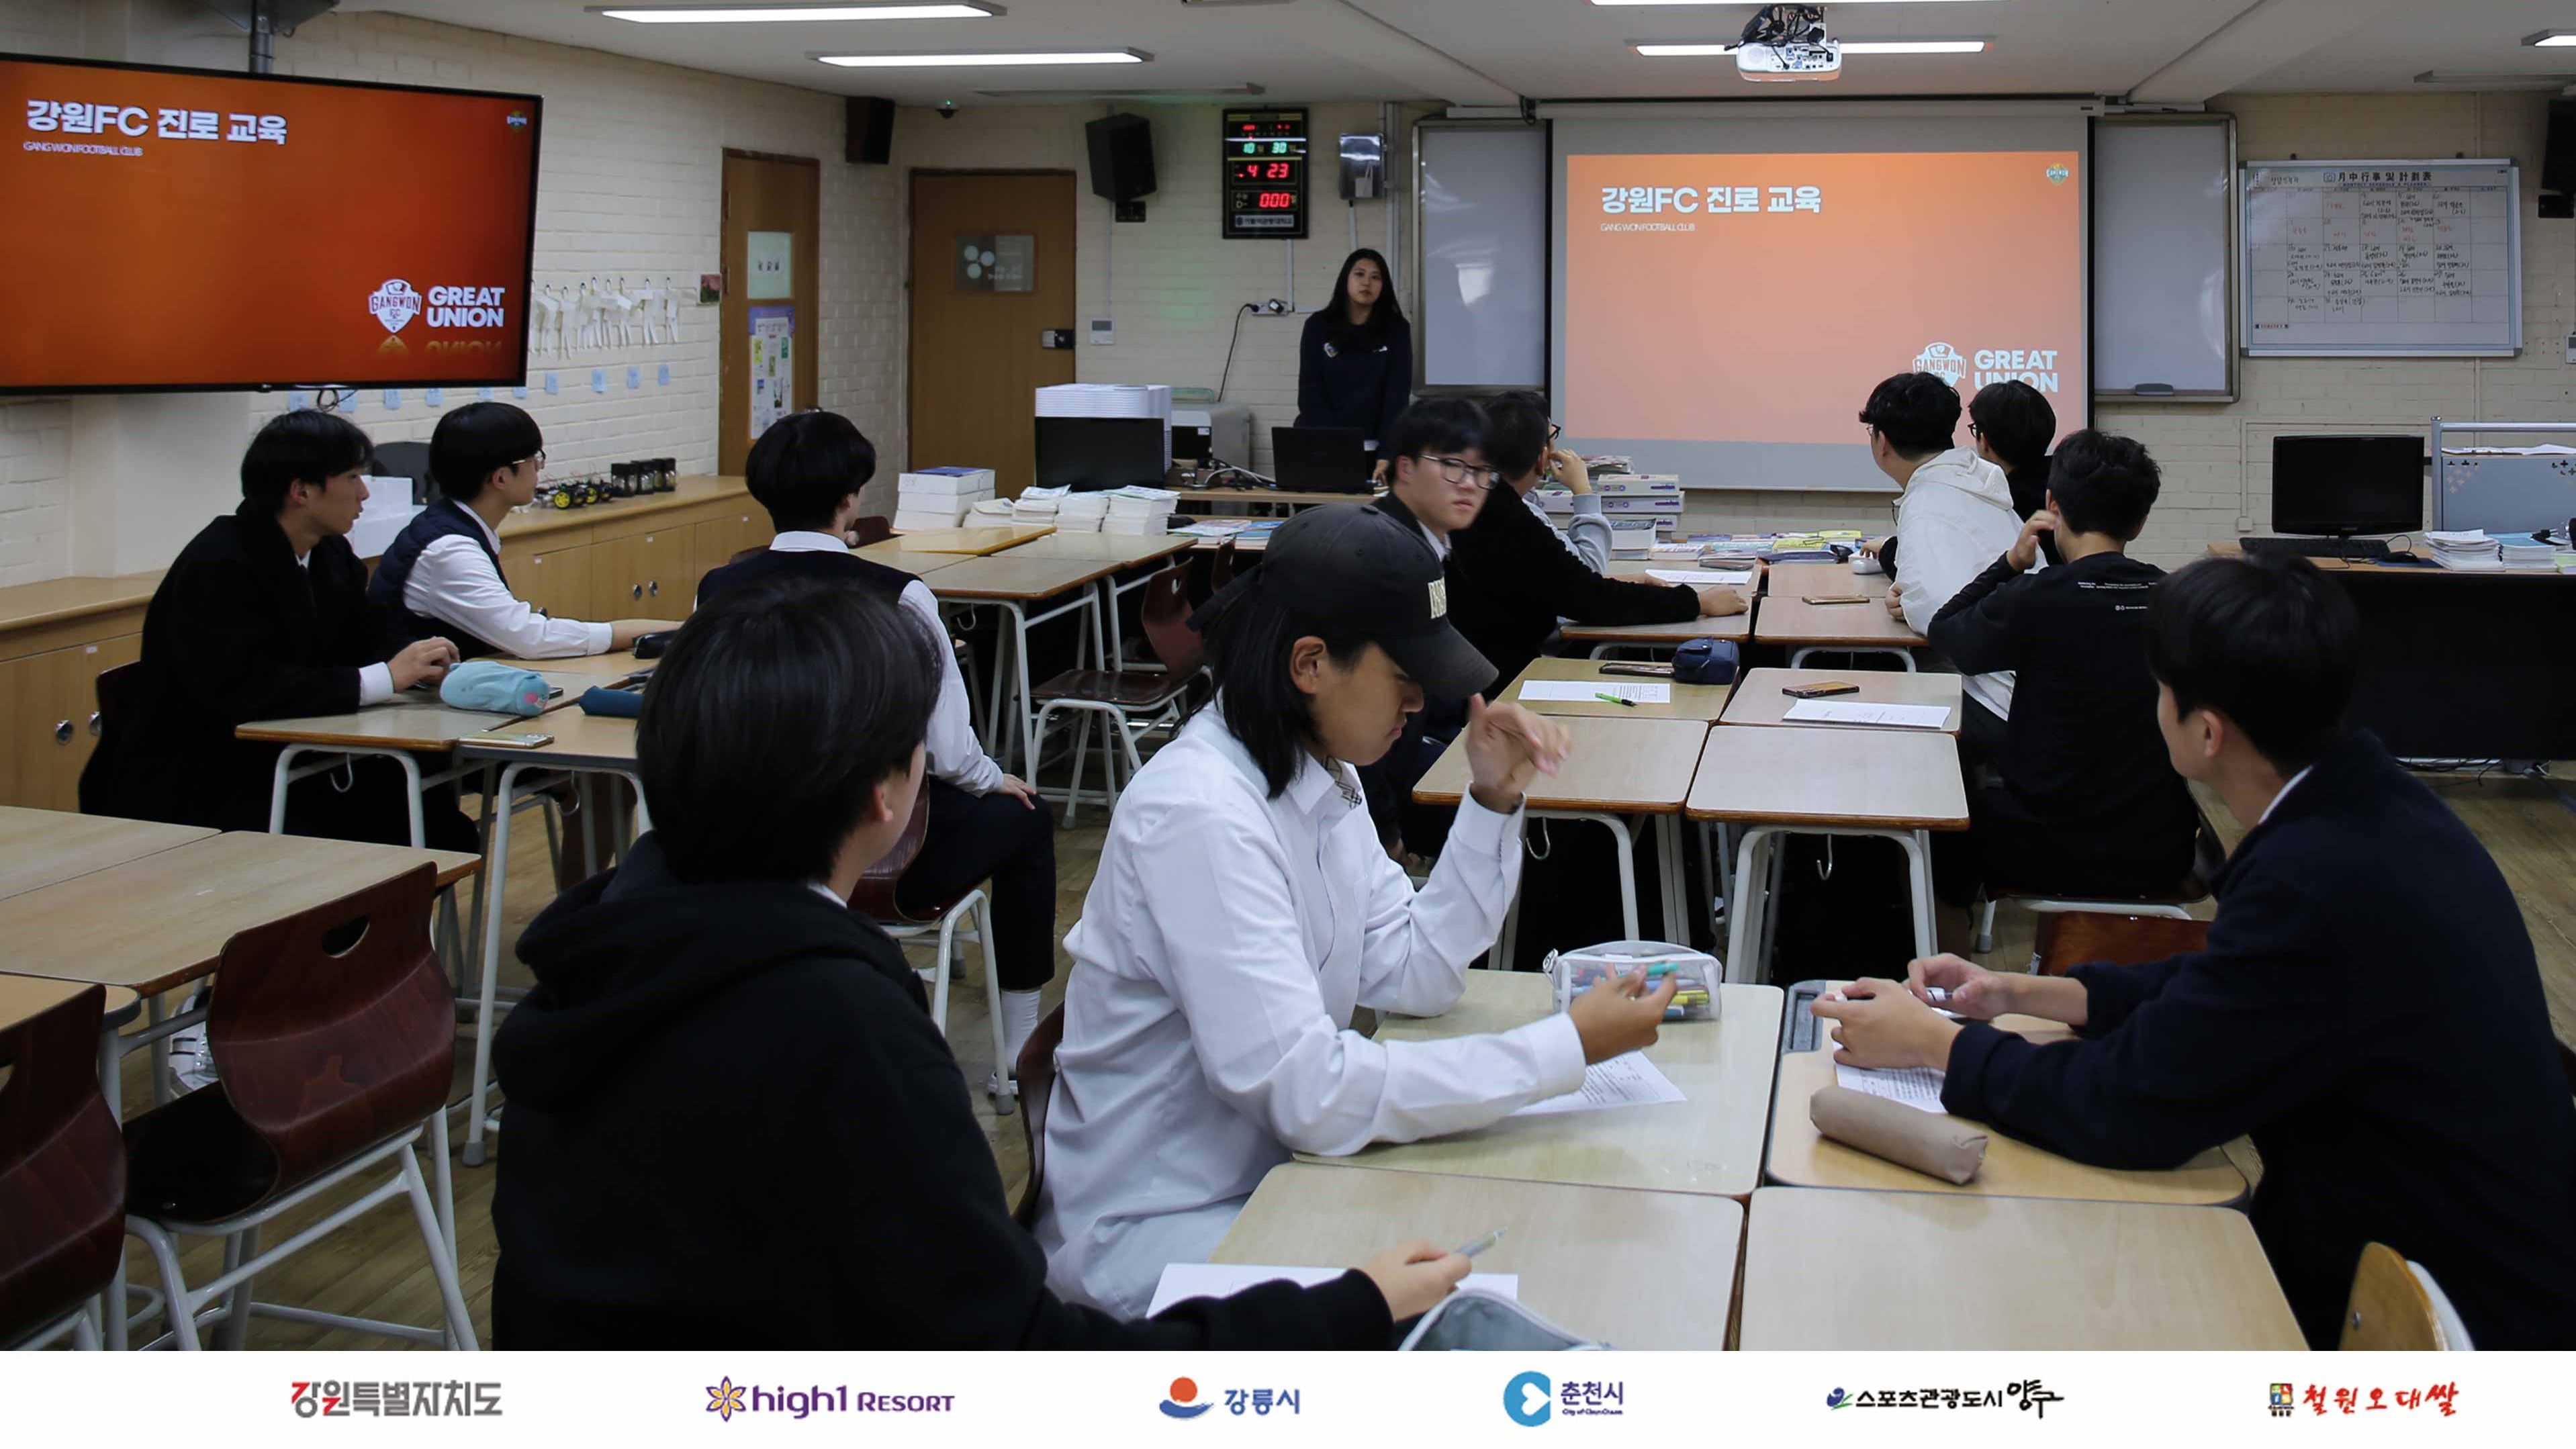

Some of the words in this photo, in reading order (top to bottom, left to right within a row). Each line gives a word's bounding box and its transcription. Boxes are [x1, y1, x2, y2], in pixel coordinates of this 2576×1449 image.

[27, 99, 150, 136] 강원FC
[158, 107, 219, 140] 진로
[226, 113, 287, 145] 교육
[24, 142, 52, 151] GANG
[120, 146, 143, 156] CLUB
[1272, 141, 1287, 154] 30
[1267, 162, 1289, 178] 23
[1602, 187, 1699, 214] 강원FC
[1706, 186, 1759, 214] 진로
[1767, 186, 1821, 214] 교육
[1601, 223, 1622, 232] GANG
[1642, 223, 1676, 232] FOOTBALL
[1677, 223, 1696, 232] CLUB
[371, 295, 420, 313] GANGWON
[428, 285, 506, 306] GREAT
[426, 306, 504, 328] UNION
[1974, 349, 2058, 370] GREAT
